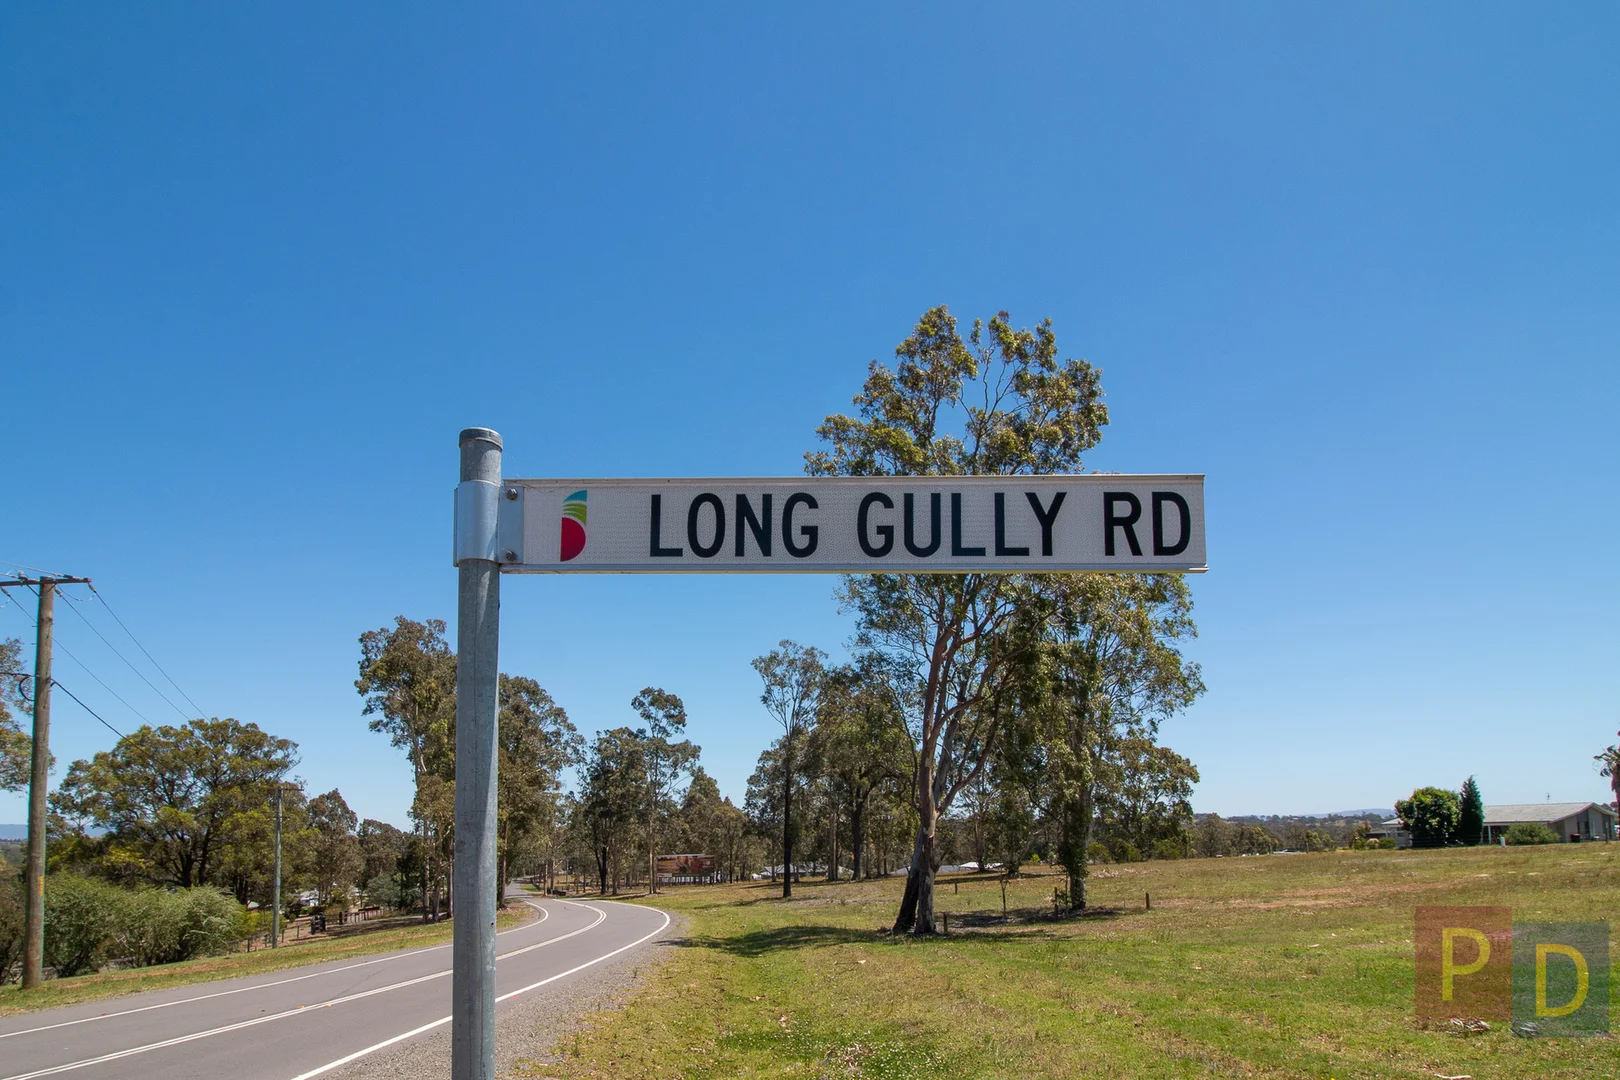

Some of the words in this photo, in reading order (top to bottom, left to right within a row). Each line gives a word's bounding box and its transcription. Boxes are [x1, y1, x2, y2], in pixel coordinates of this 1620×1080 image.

[650, 492, 819, 558] LONG
[857, 492, 1067, 558] GULLY
[1103, 491, 1191, 557] RD
